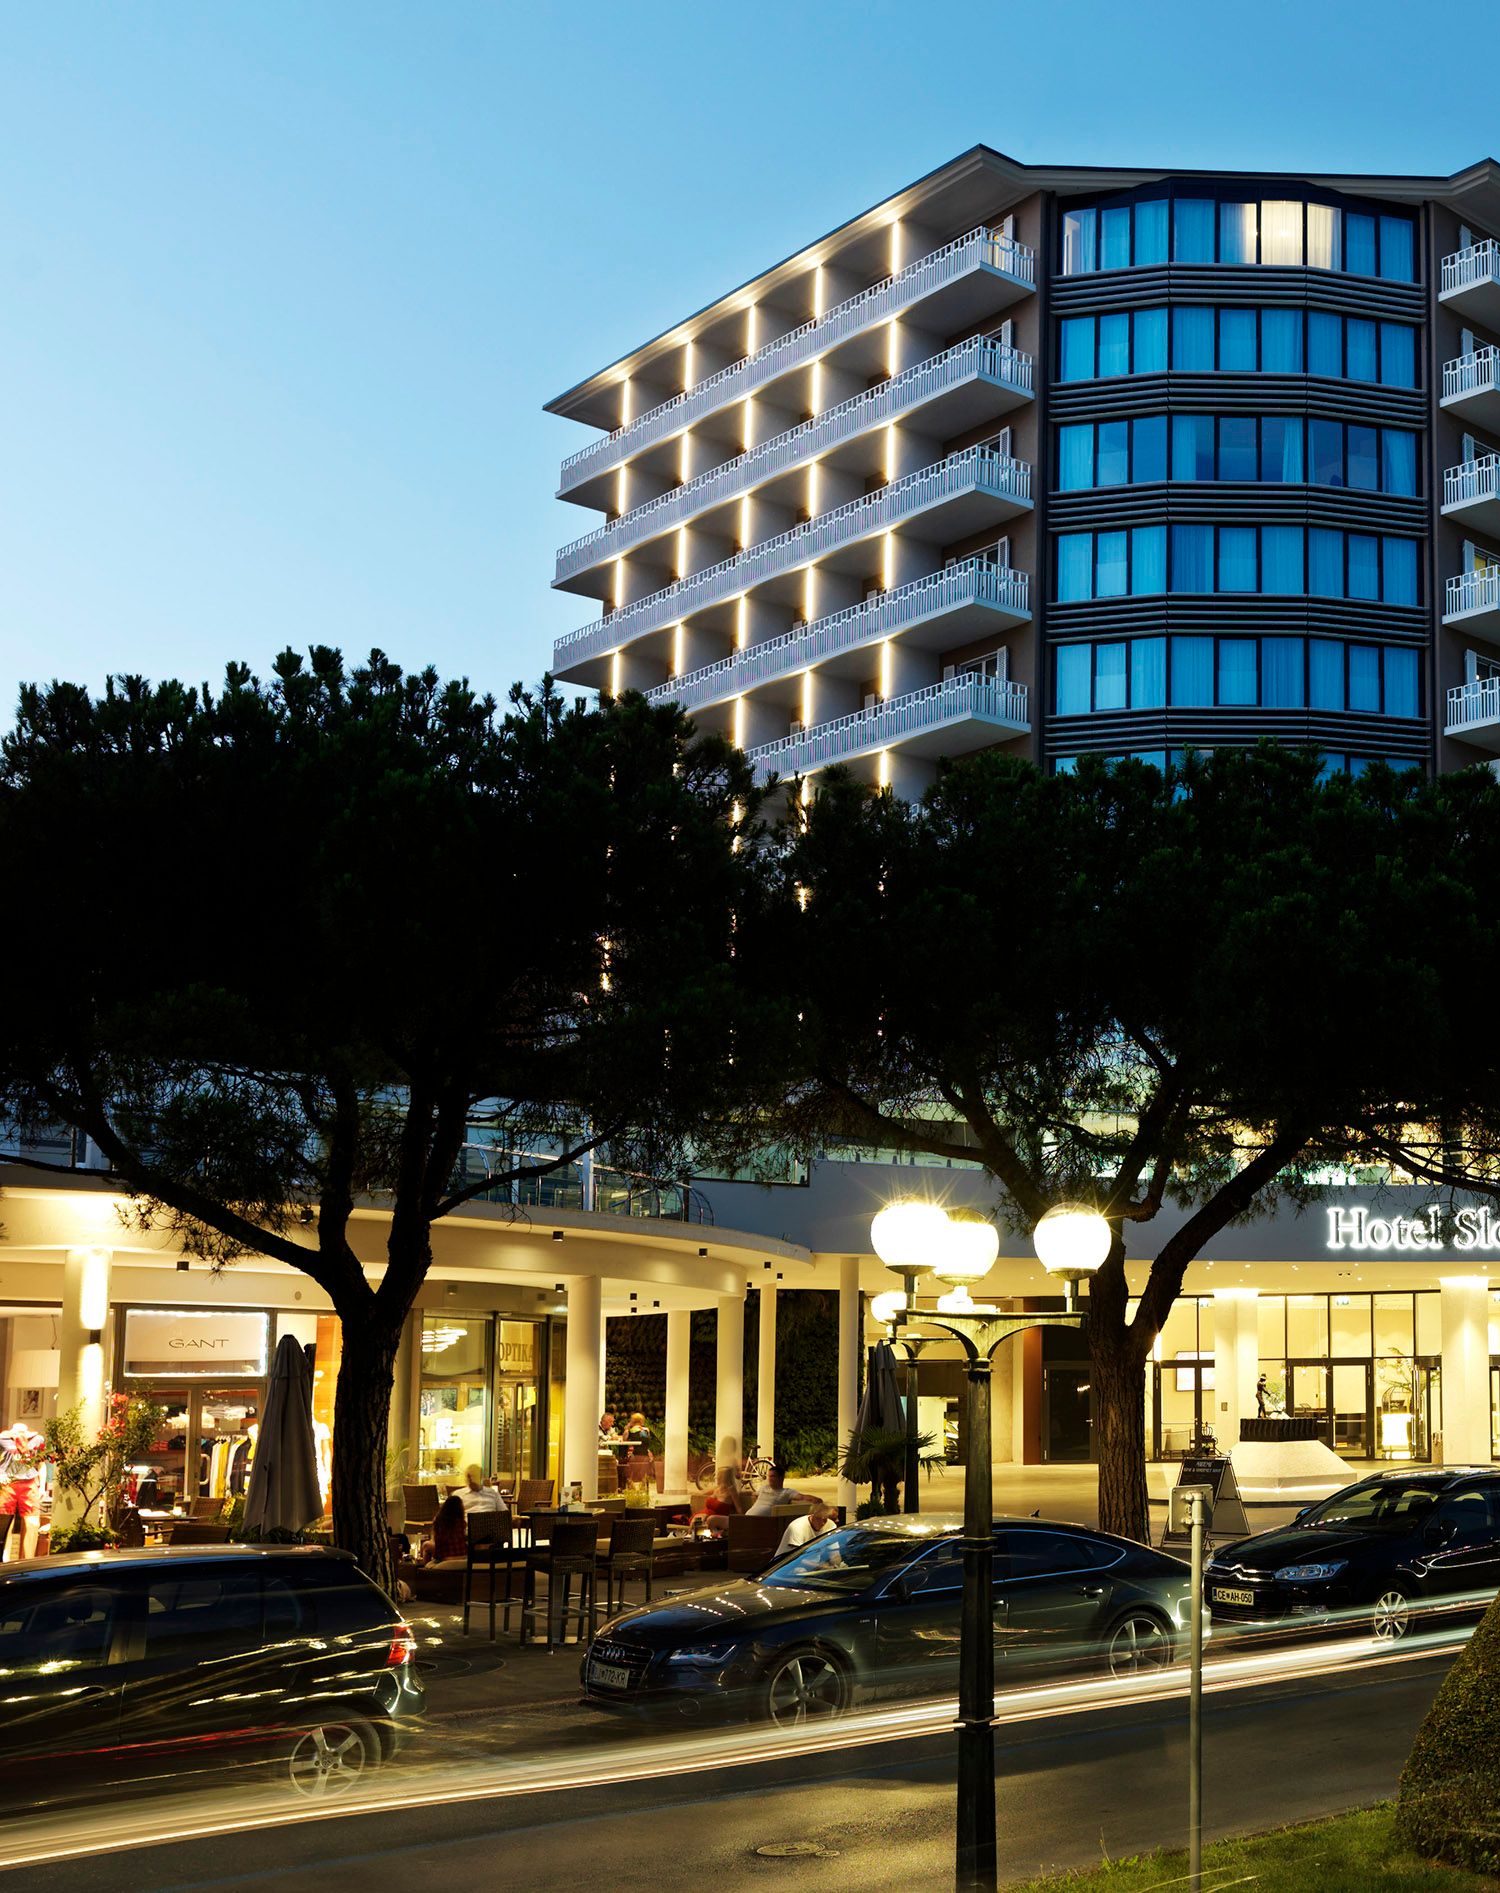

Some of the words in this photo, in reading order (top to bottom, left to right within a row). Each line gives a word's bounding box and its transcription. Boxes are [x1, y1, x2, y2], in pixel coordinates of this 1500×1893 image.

[1327, 1205, 1445, 1249] Hotel
[168, 1338, 230, 1349] GANT
[1217, 1590, 1226, 1600] CE
[1230, 1592, 1252, 1604] AH-050
